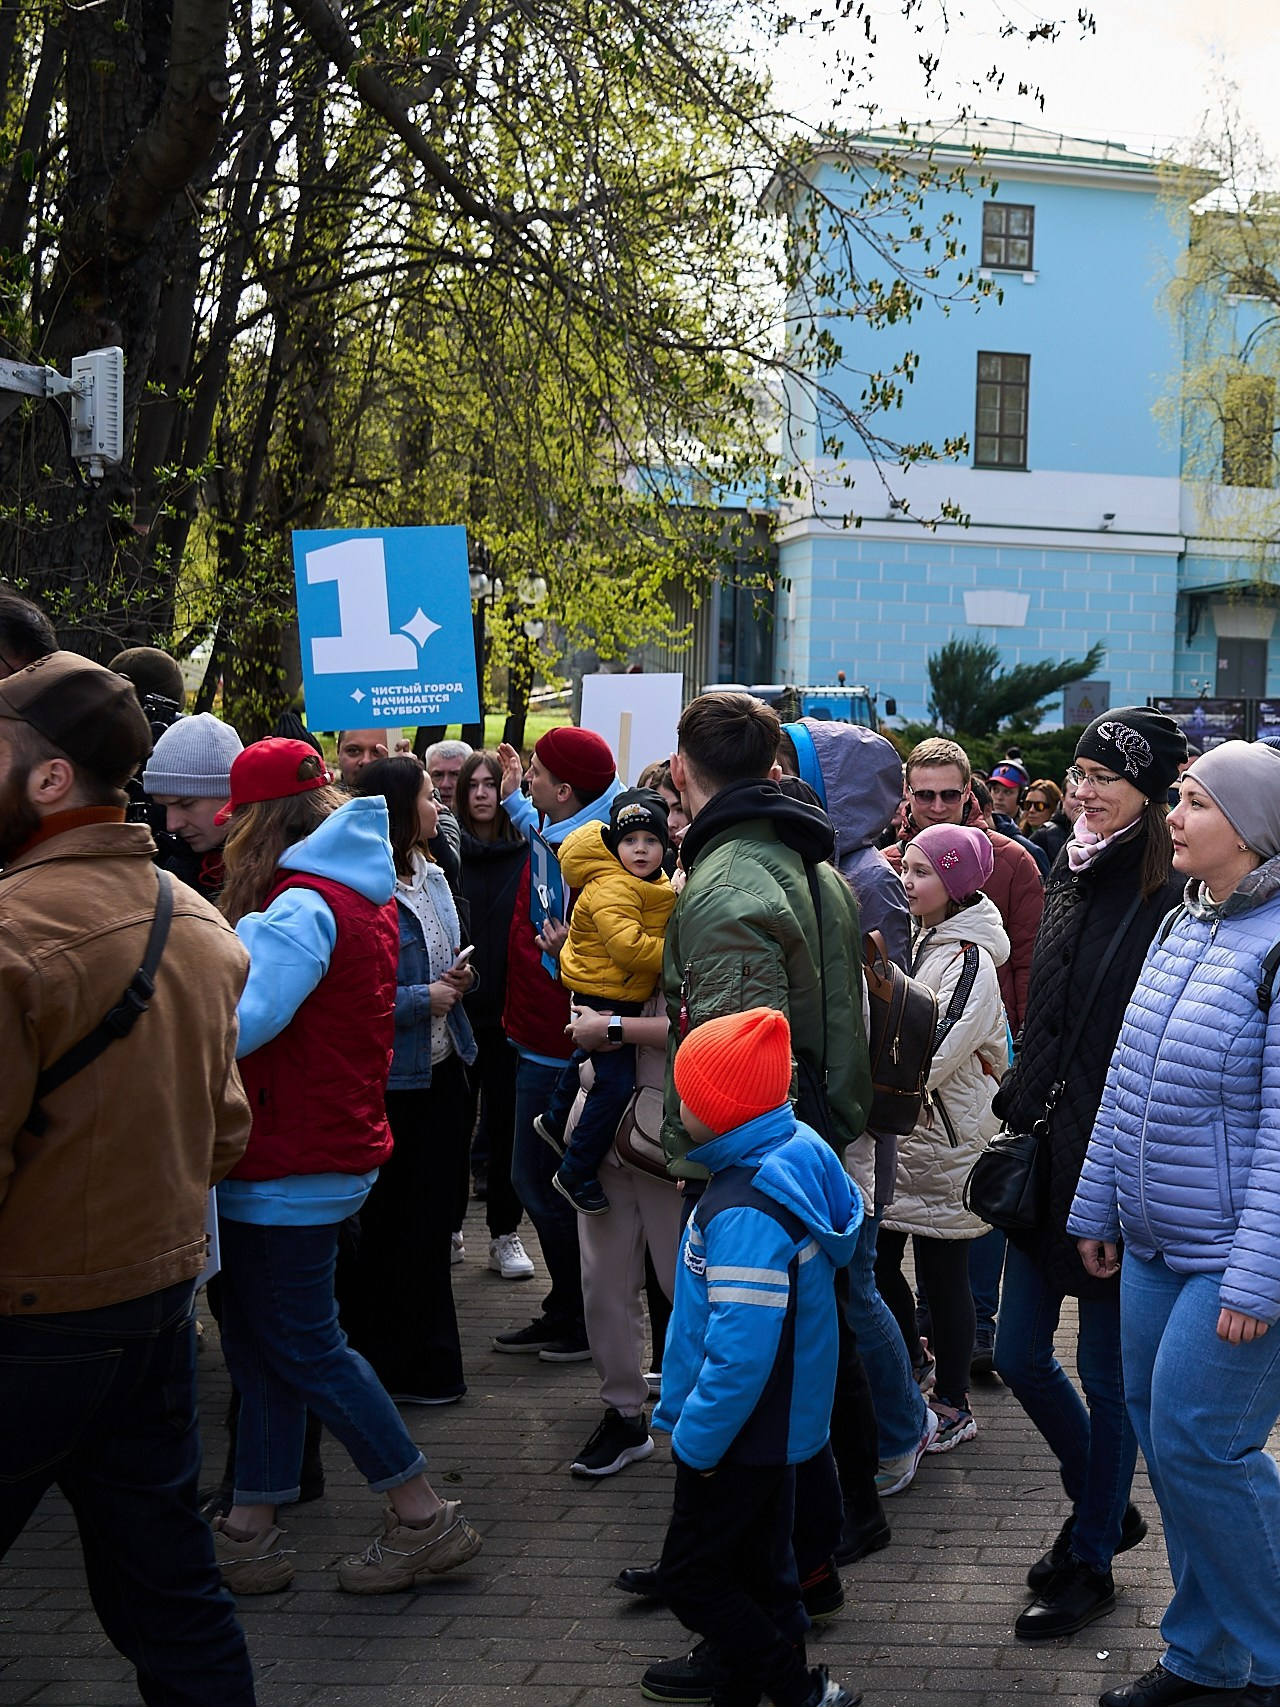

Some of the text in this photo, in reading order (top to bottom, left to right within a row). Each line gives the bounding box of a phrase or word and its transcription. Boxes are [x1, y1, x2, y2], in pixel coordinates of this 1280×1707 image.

[372, 683, 463, 695] ЧИСТЫЙ ГОРОД
[372, 693, 450, 706] НАЧИНАЕТСЯ
[373, 705, 440, 716] В СУББОТУ!
